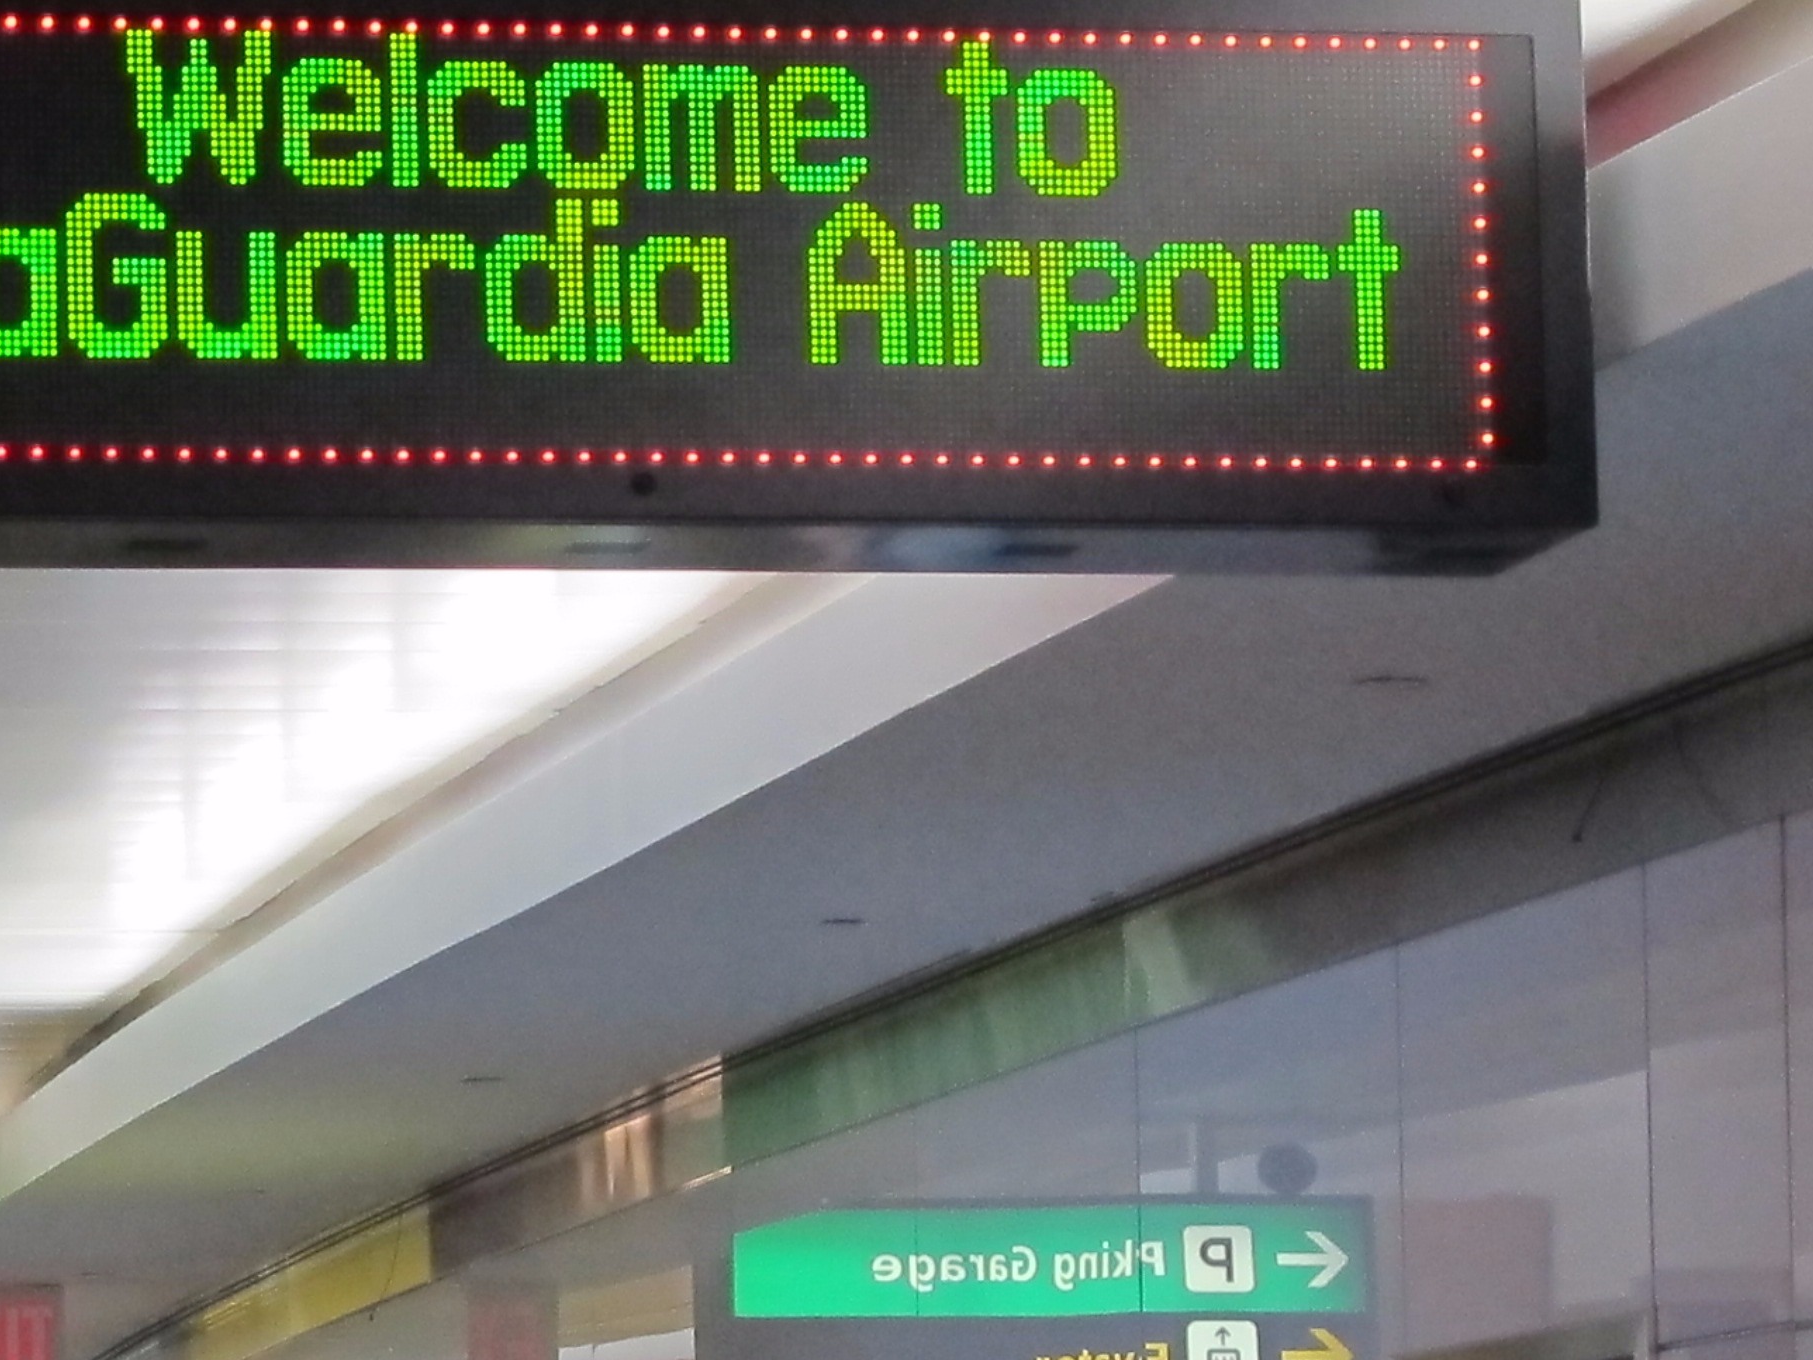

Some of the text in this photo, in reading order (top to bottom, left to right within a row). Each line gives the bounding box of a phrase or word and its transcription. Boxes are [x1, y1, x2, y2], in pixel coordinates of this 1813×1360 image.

[126, 29, 1120, 199] Welcome to
[805, 202, 1399, 370] Airport
